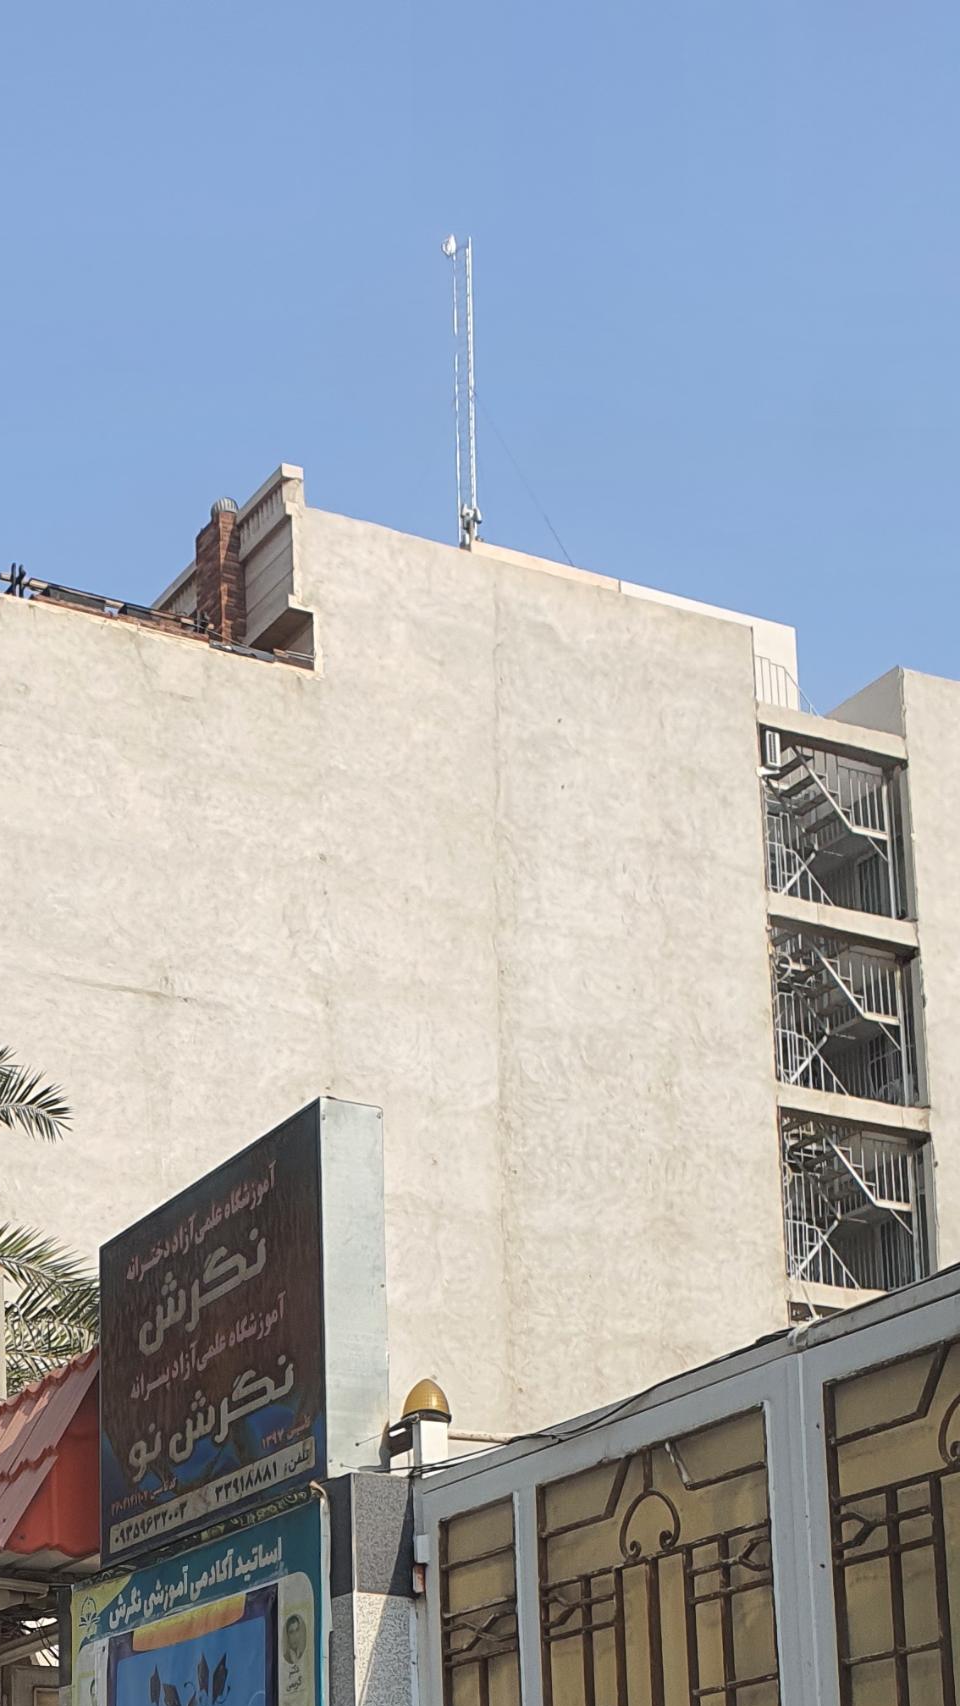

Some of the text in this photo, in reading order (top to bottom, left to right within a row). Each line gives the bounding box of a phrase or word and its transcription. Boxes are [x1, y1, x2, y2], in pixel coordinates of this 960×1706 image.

[126, 1159, 277, 1282] آموزشگاه علمی آزاد دخترانه
[130, 1291, 287, 1402] آموزشگاه علمی آزاد پسرانه
[139, 1227, 267, 1356] نگرش
[128, 1354, 295, 1483] نگرش نو
[108, 1536, 283, 1629] اساتید آکادمی آموزشی نگرش
